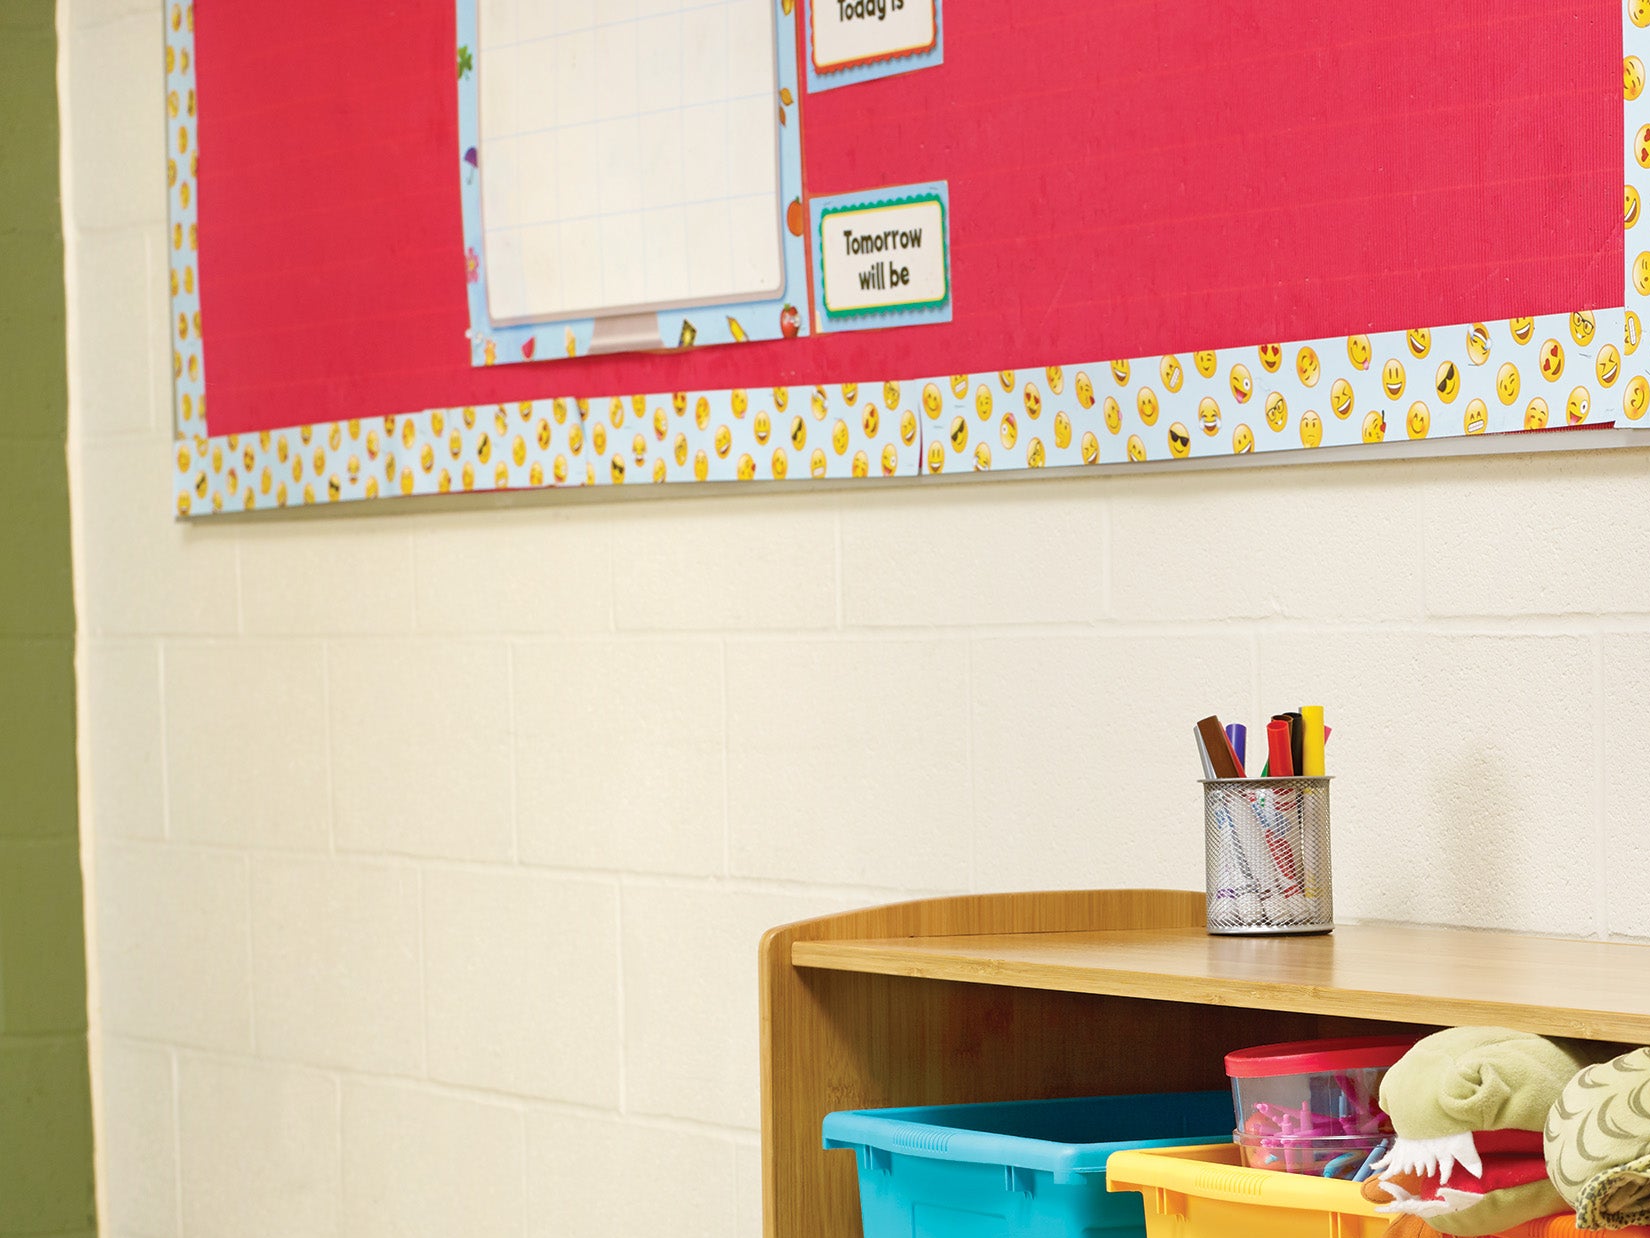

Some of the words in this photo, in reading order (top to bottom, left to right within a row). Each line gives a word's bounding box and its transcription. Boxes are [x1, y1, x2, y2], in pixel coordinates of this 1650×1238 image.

[837, 0, 886, 22] Today
[843, 228, 922, 256] Tomorrow
[859, 262, 885, 290] will
[889, 261, 910, 288] be
